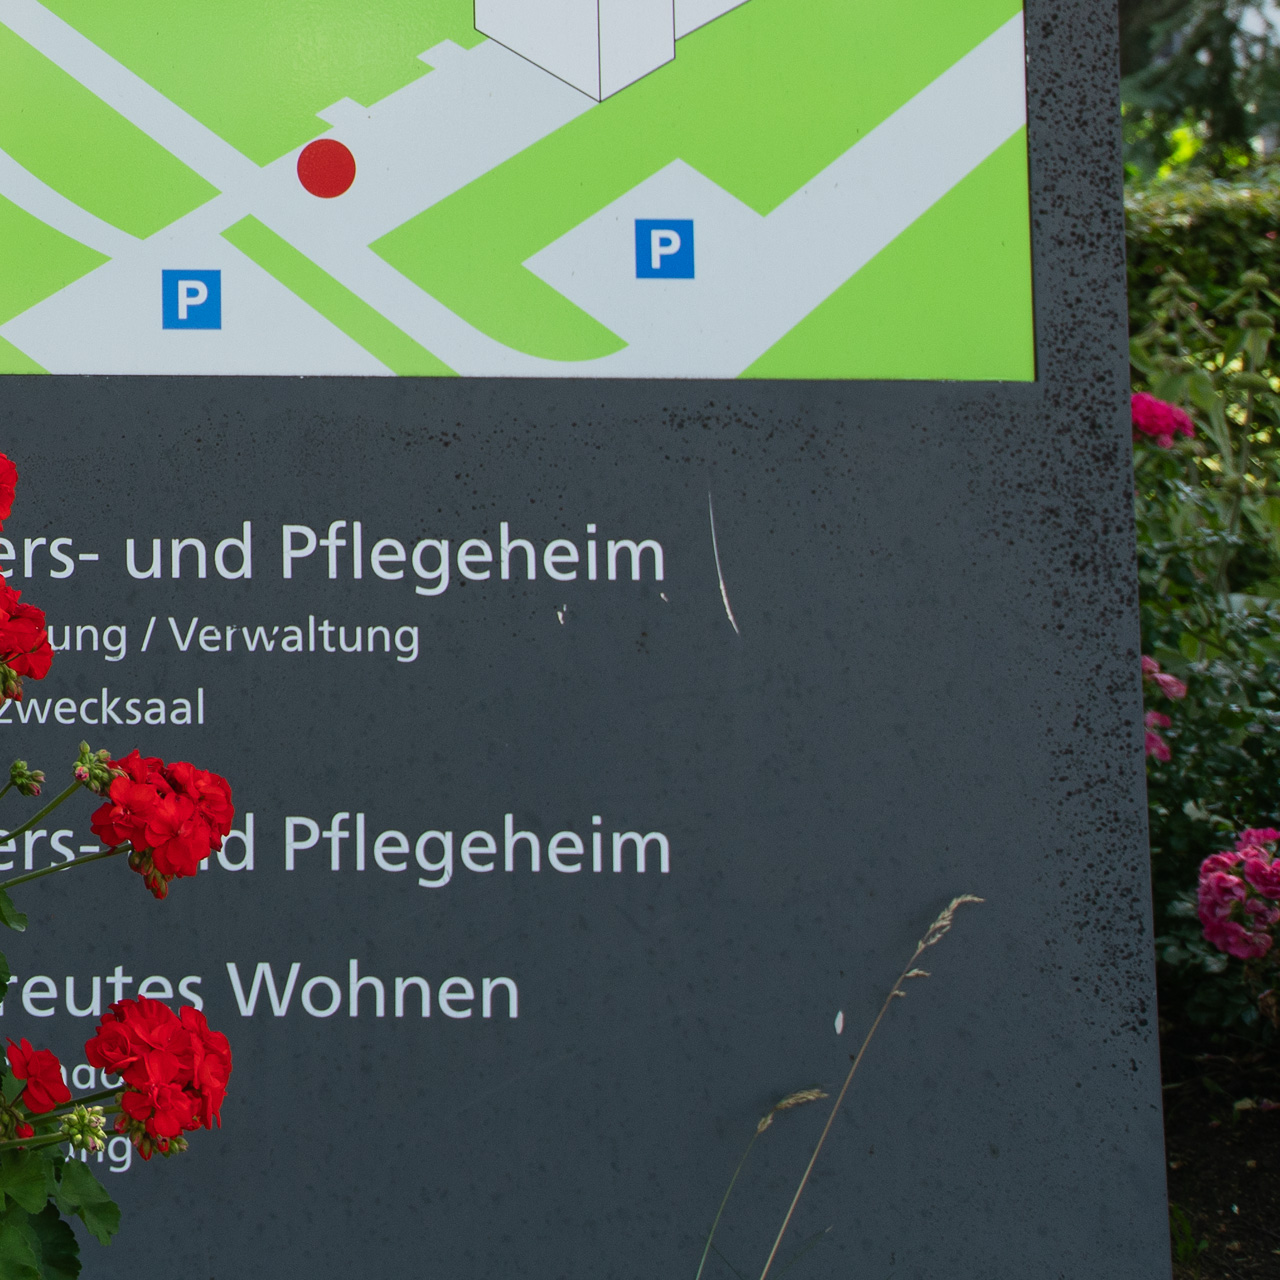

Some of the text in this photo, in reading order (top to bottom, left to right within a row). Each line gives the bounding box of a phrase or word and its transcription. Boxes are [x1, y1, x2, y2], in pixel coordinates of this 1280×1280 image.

[125, 519, 253, 581] und
[281, 519, 665, 597] Pflegeheim
[167, 614, 420, 663] Verwaltung
[284, 811, 671, 889] Pflegeheim
[225, 958, 519, 1019] Wohnen
